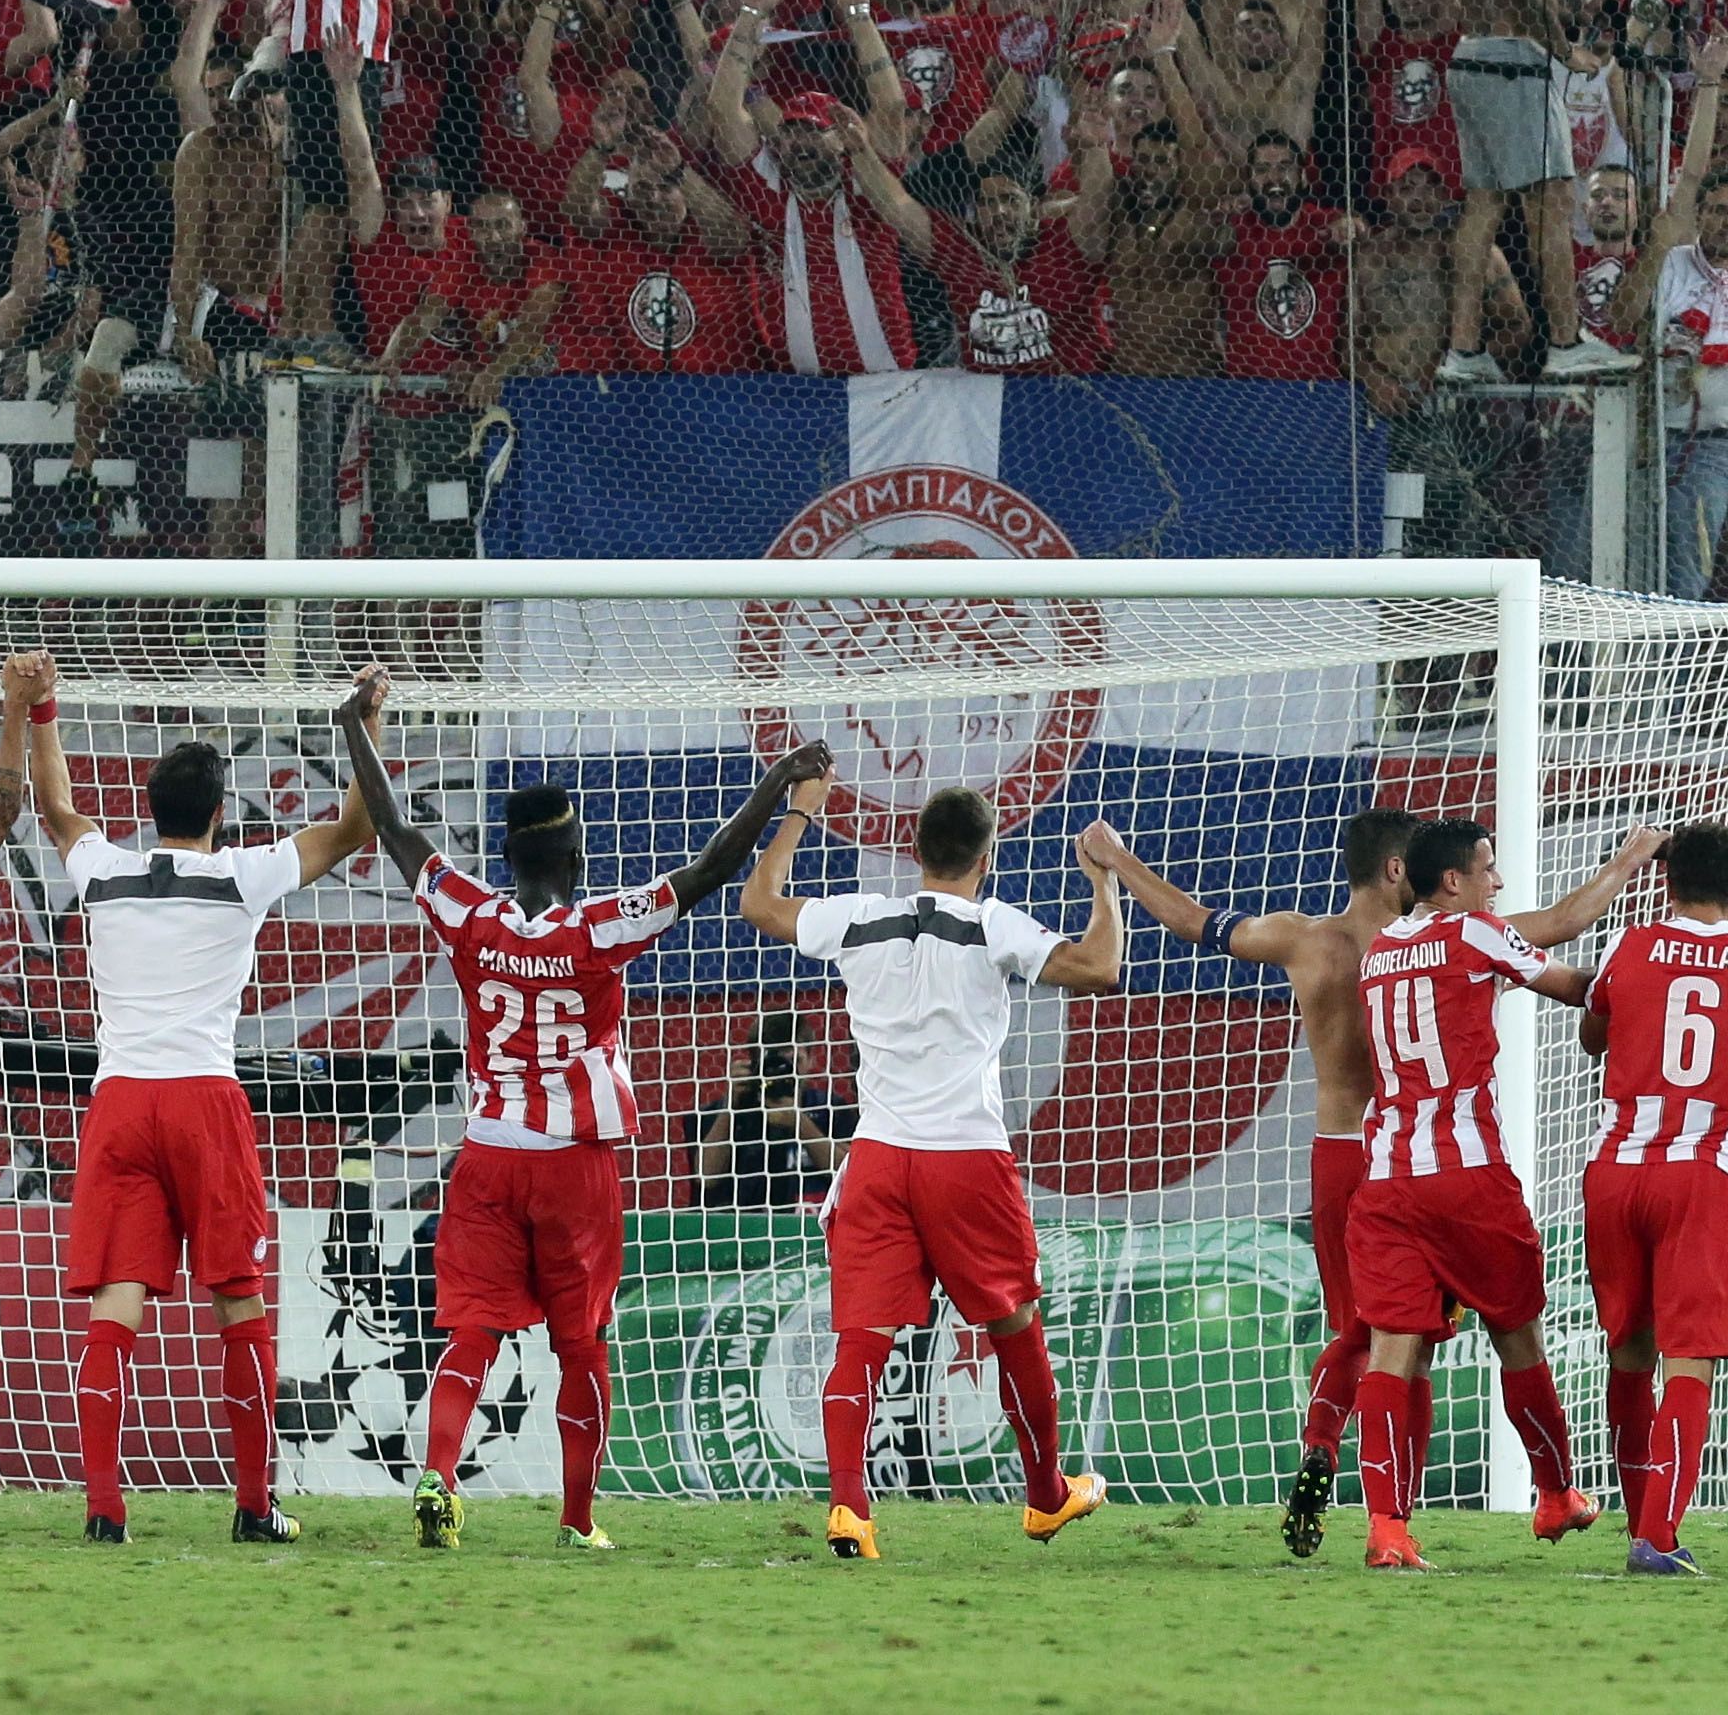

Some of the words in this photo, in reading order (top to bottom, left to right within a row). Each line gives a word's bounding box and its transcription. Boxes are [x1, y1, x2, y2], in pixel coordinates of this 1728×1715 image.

[788, 473, 1057, 559] ΟΛΥΜΠΙΑΚΟΣ
[955, 712, 1016, 742] 1925
[477, 978, 588, 1074] 26
[1365, 976, 1449, 1099] 14
[1662, 975, 1720, 1087] 6
